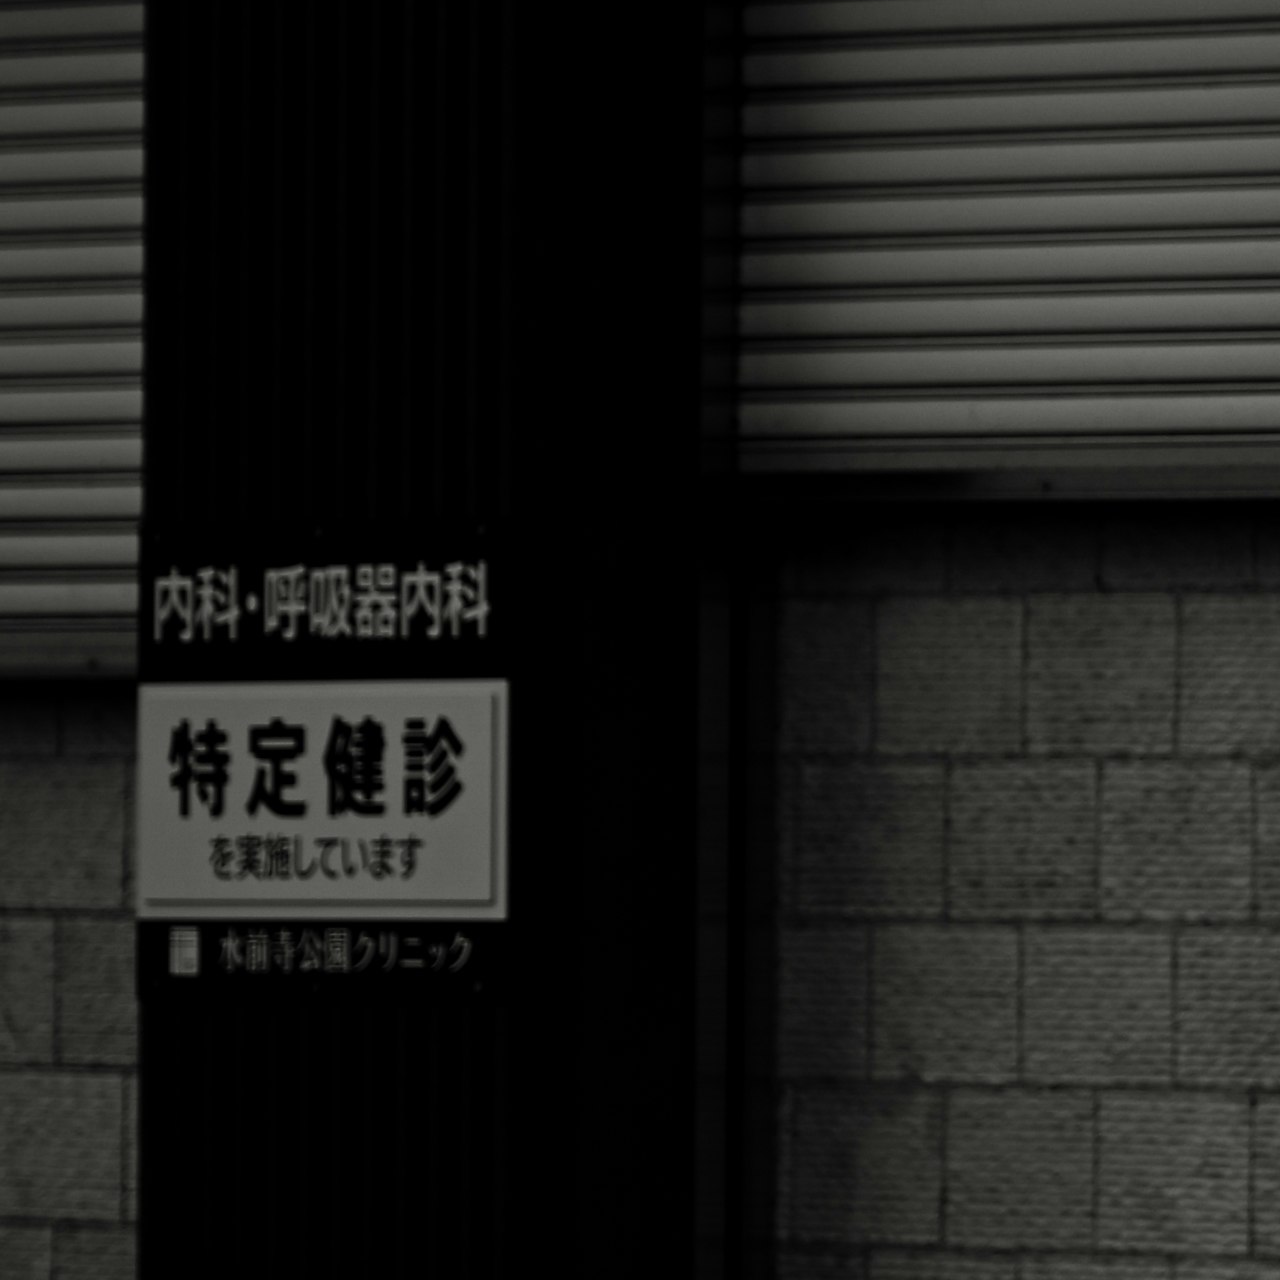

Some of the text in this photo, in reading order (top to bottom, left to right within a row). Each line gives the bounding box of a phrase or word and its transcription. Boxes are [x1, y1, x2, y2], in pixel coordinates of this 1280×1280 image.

[152, 559, 491, 645] 内科・呼吸器内科
[168, 716, 463, 818] 特定健診
[208, 832, 424, 880] を実施しています
